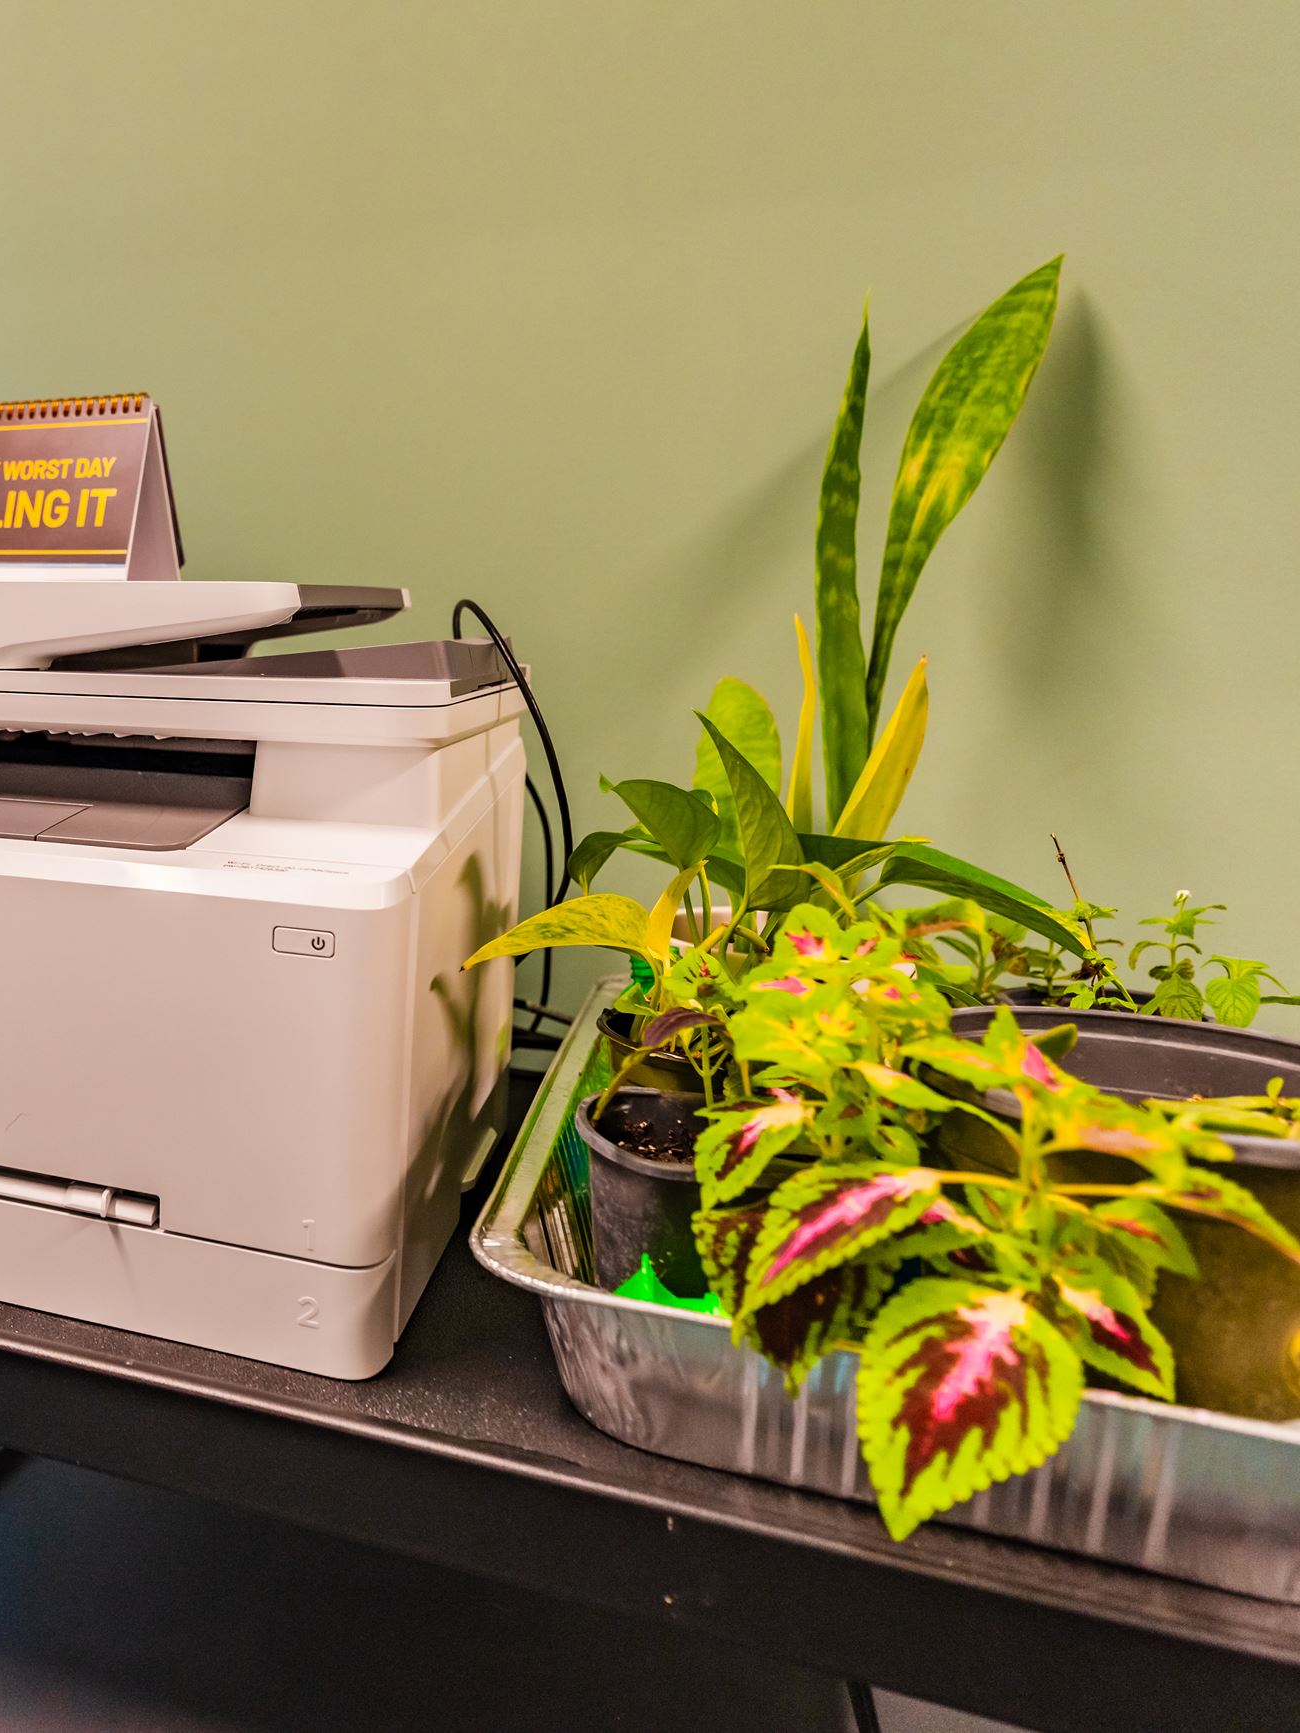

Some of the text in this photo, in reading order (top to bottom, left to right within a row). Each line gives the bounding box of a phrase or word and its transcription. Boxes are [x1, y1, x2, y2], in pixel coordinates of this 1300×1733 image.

[2, 458, 72, 480] WORST
[74, 456, 117, 479] DAY
[75, 487, 118, 528] IT
[296, 1294, 322, 1331] 2
